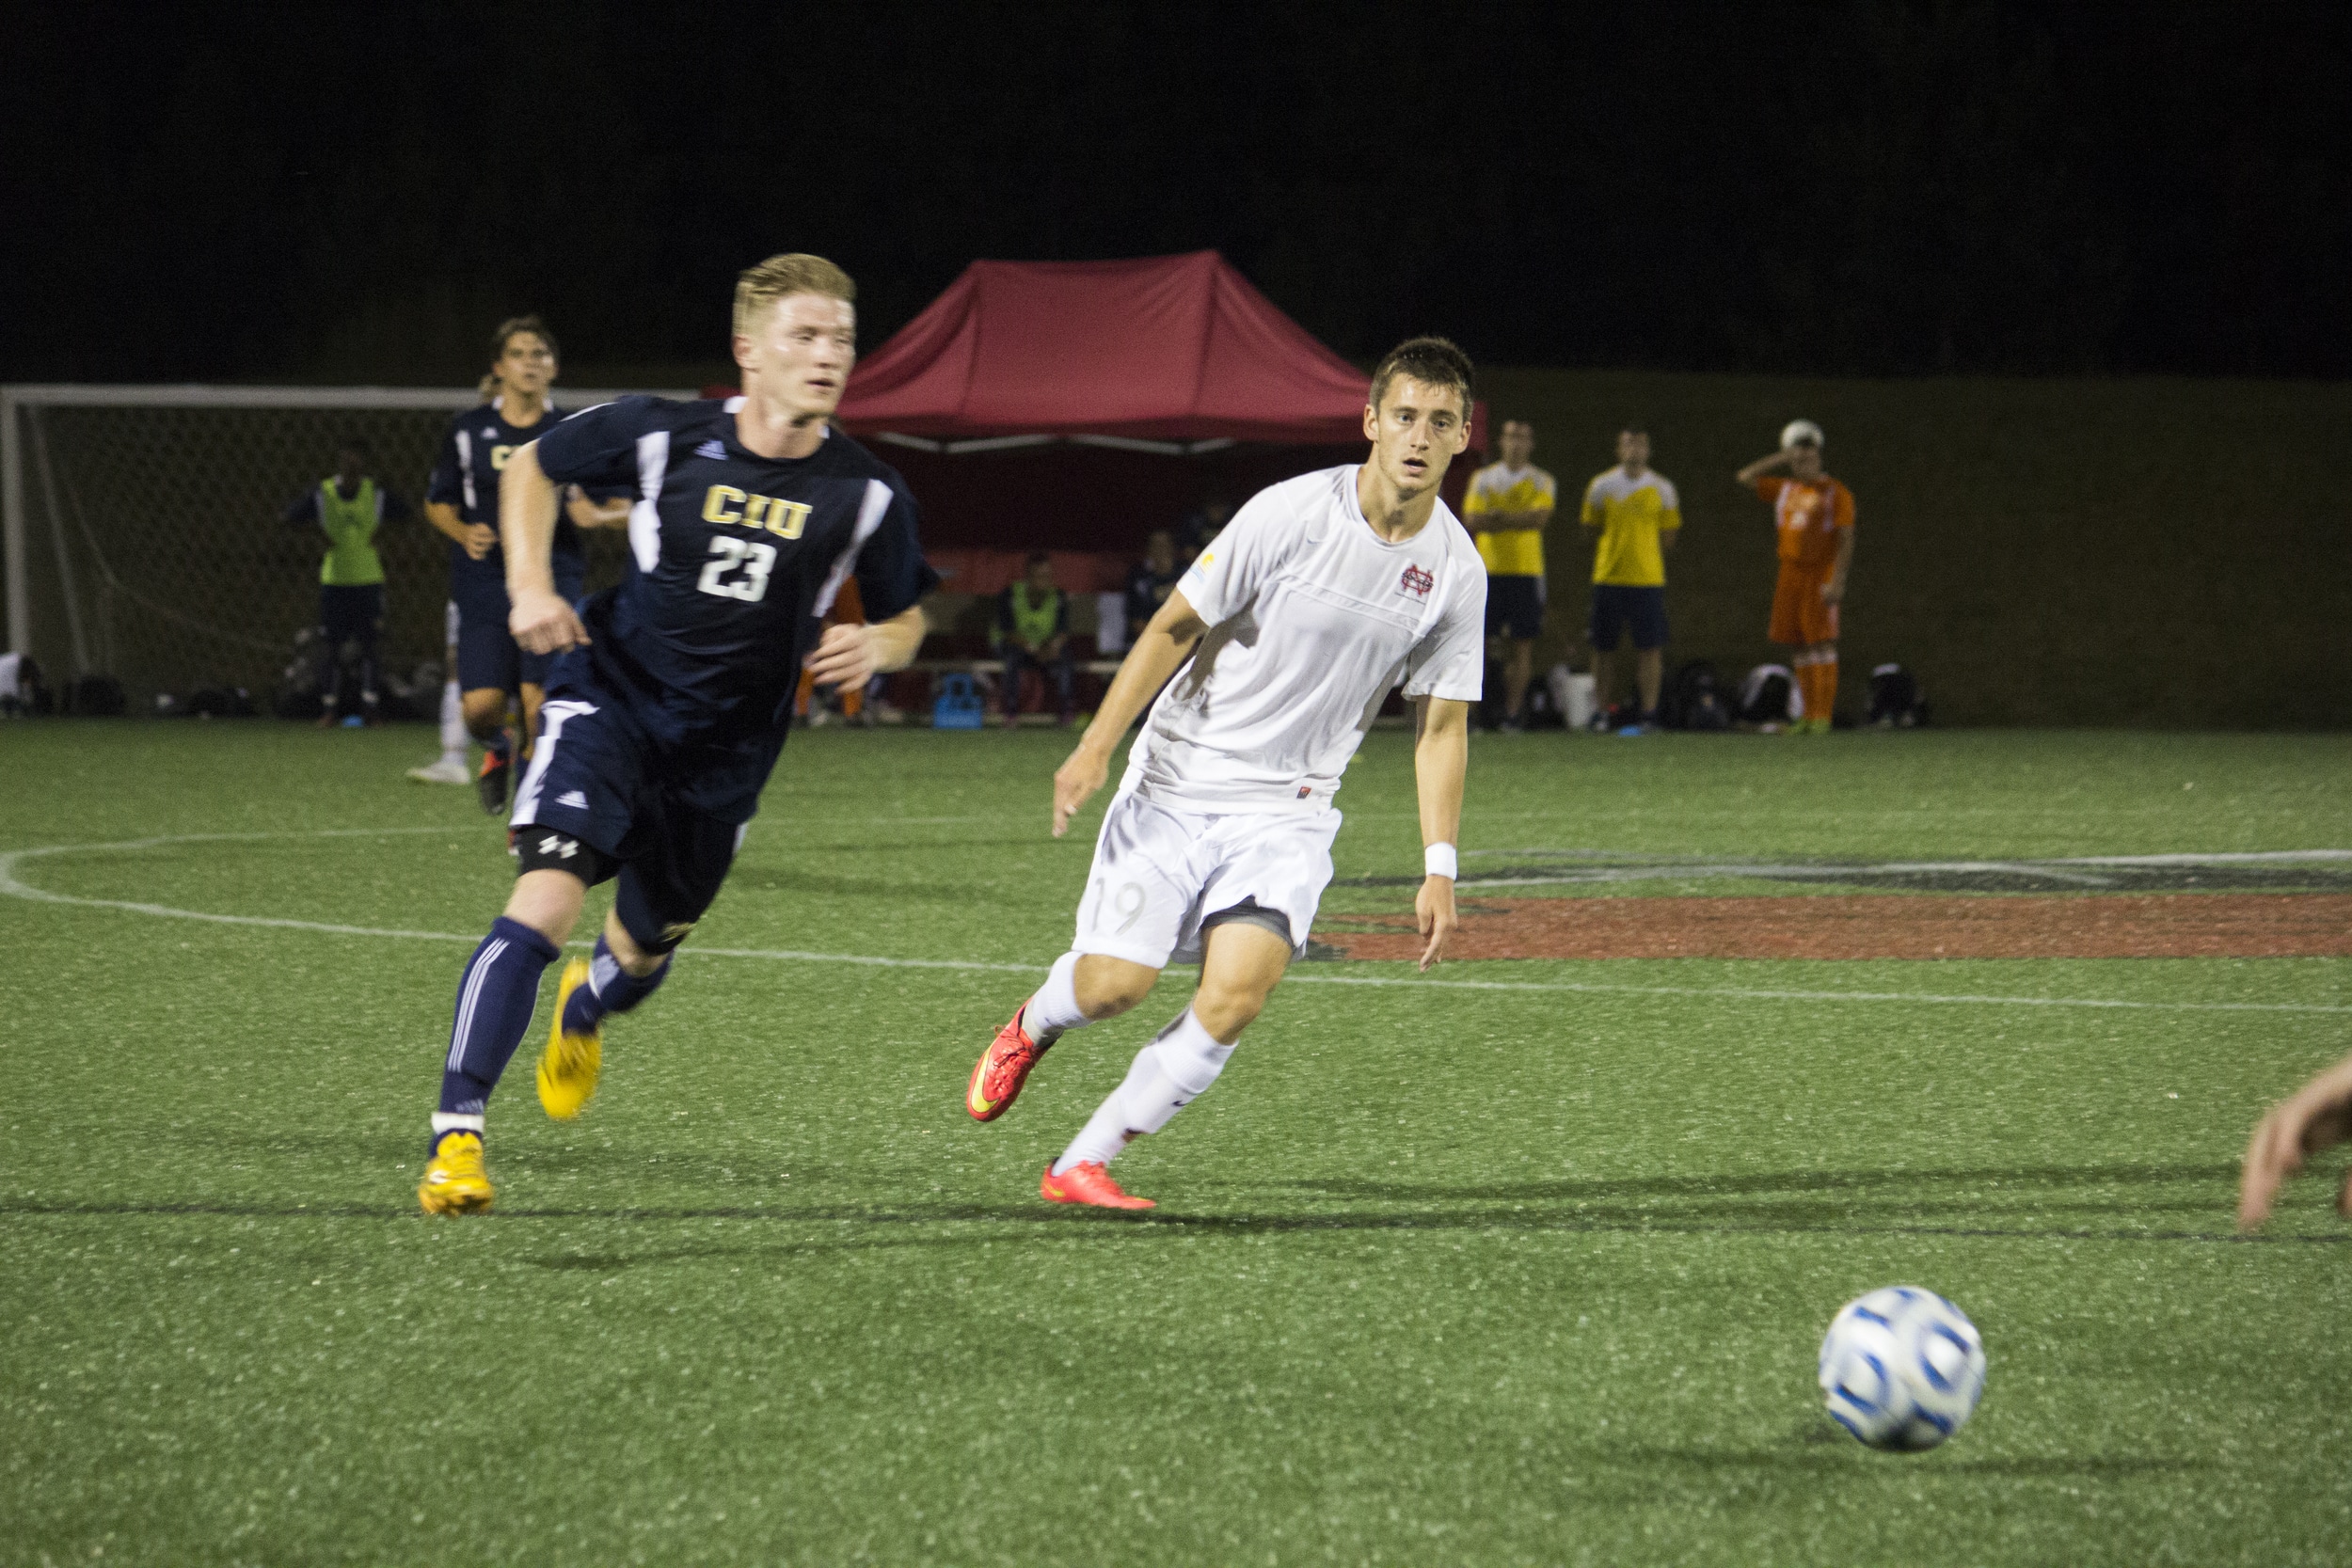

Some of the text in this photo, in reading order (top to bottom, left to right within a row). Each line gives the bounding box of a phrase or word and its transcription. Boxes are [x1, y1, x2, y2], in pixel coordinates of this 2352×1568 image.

[701, 483, 814, 540] CIU
[697, 534, 777, 602] 23
[1091, 877, 1146, 937] 19
